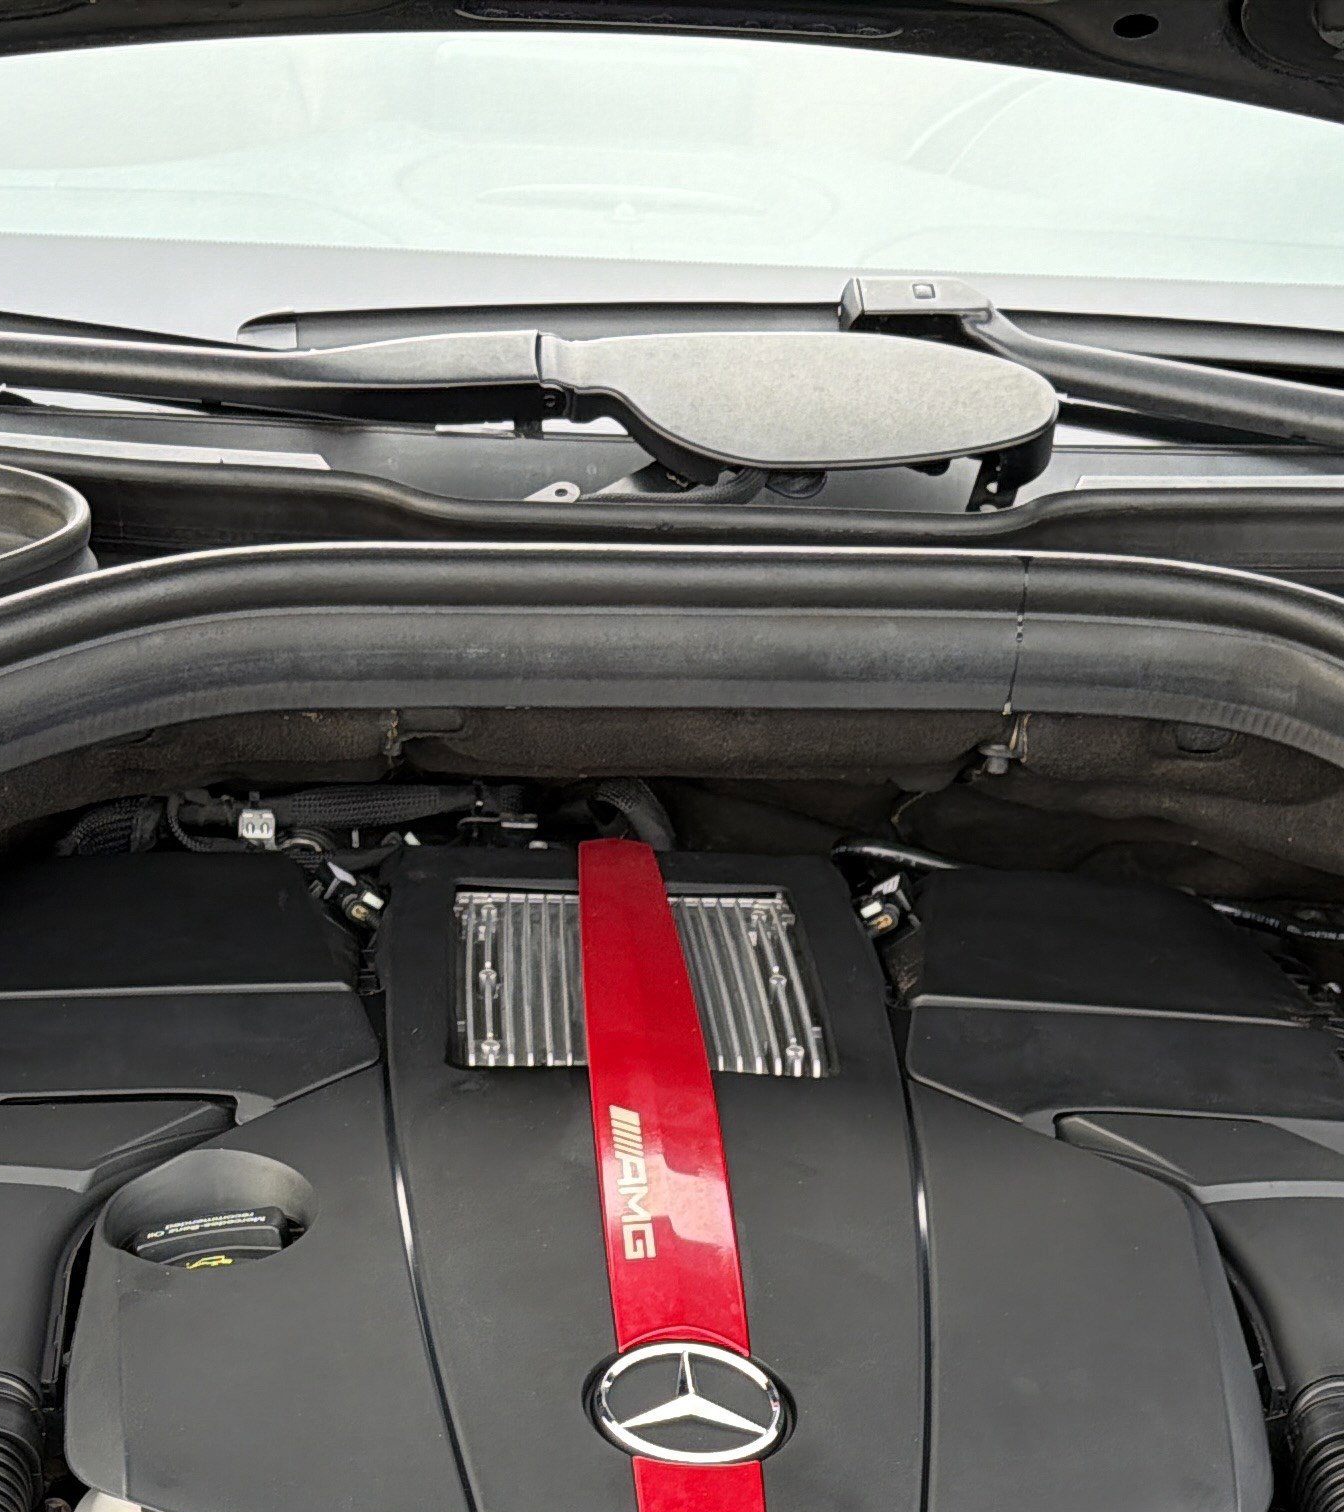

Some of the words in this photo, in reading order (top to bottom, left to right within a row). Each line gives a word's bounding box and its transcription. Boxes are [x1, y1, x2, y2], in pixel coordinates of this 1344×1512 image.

[165, 1212, 254, 1230] recommended
[168, 1216, 266, 1234] Mercedes-Benz
[147, 1230, 165, 1239] Oil
